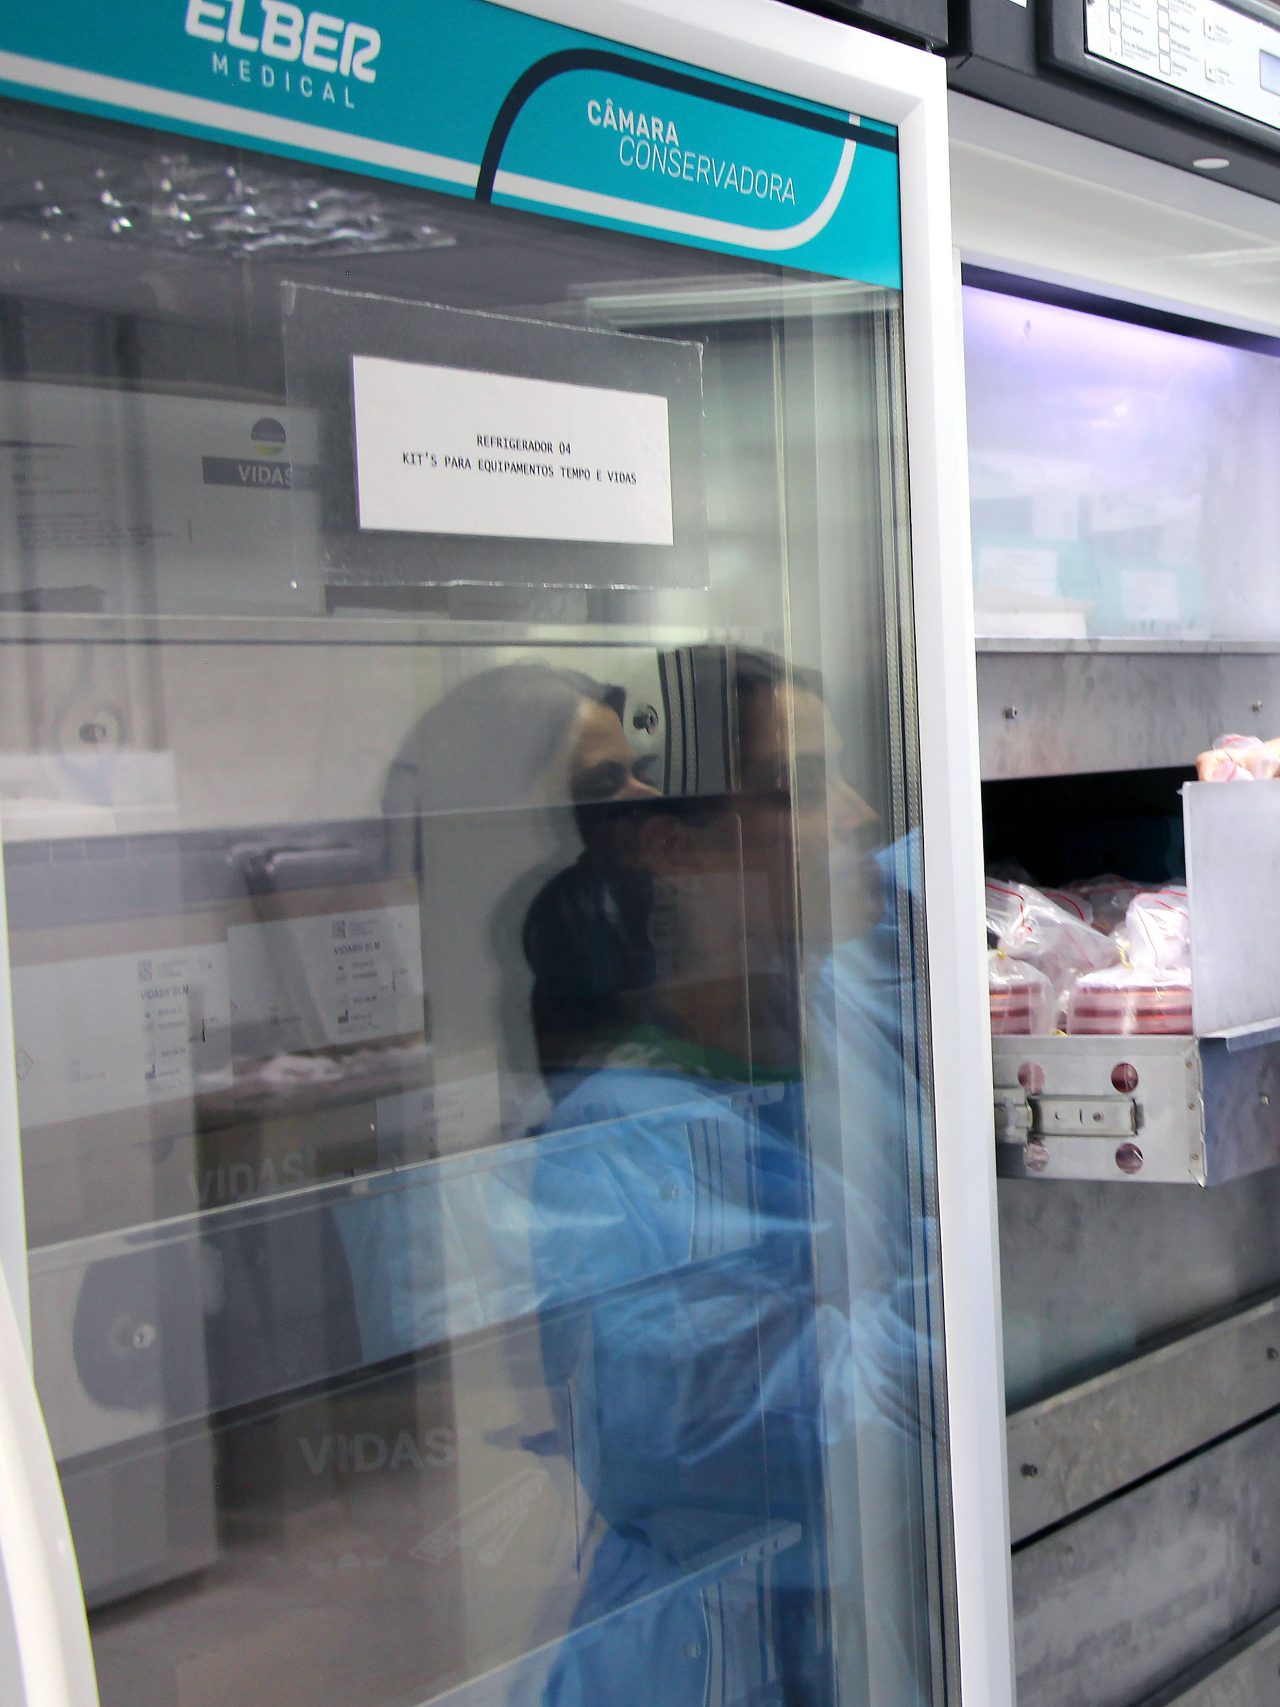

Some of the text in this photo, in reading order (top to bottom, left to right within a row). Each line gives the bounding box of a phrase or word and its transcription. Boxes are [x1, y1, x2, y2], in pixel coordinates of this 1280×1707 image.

[184, 0, 381, 84] ELBER
[212, 52, 356, 109] MEDICAL
[587, 97, 680, 147] CÂMARA
[619, 135, 796, 205] CONSERVADORA
[402, 451, 637, 485] KIT'S PARA EQUIPAMENTOS TEMPO E VIDAS
[476, 434, 571, 455] REFRIGERADOR 04
[238, 463, 292, 486] VIDAS
[300, 1427, 456, 1475] VIDAS
